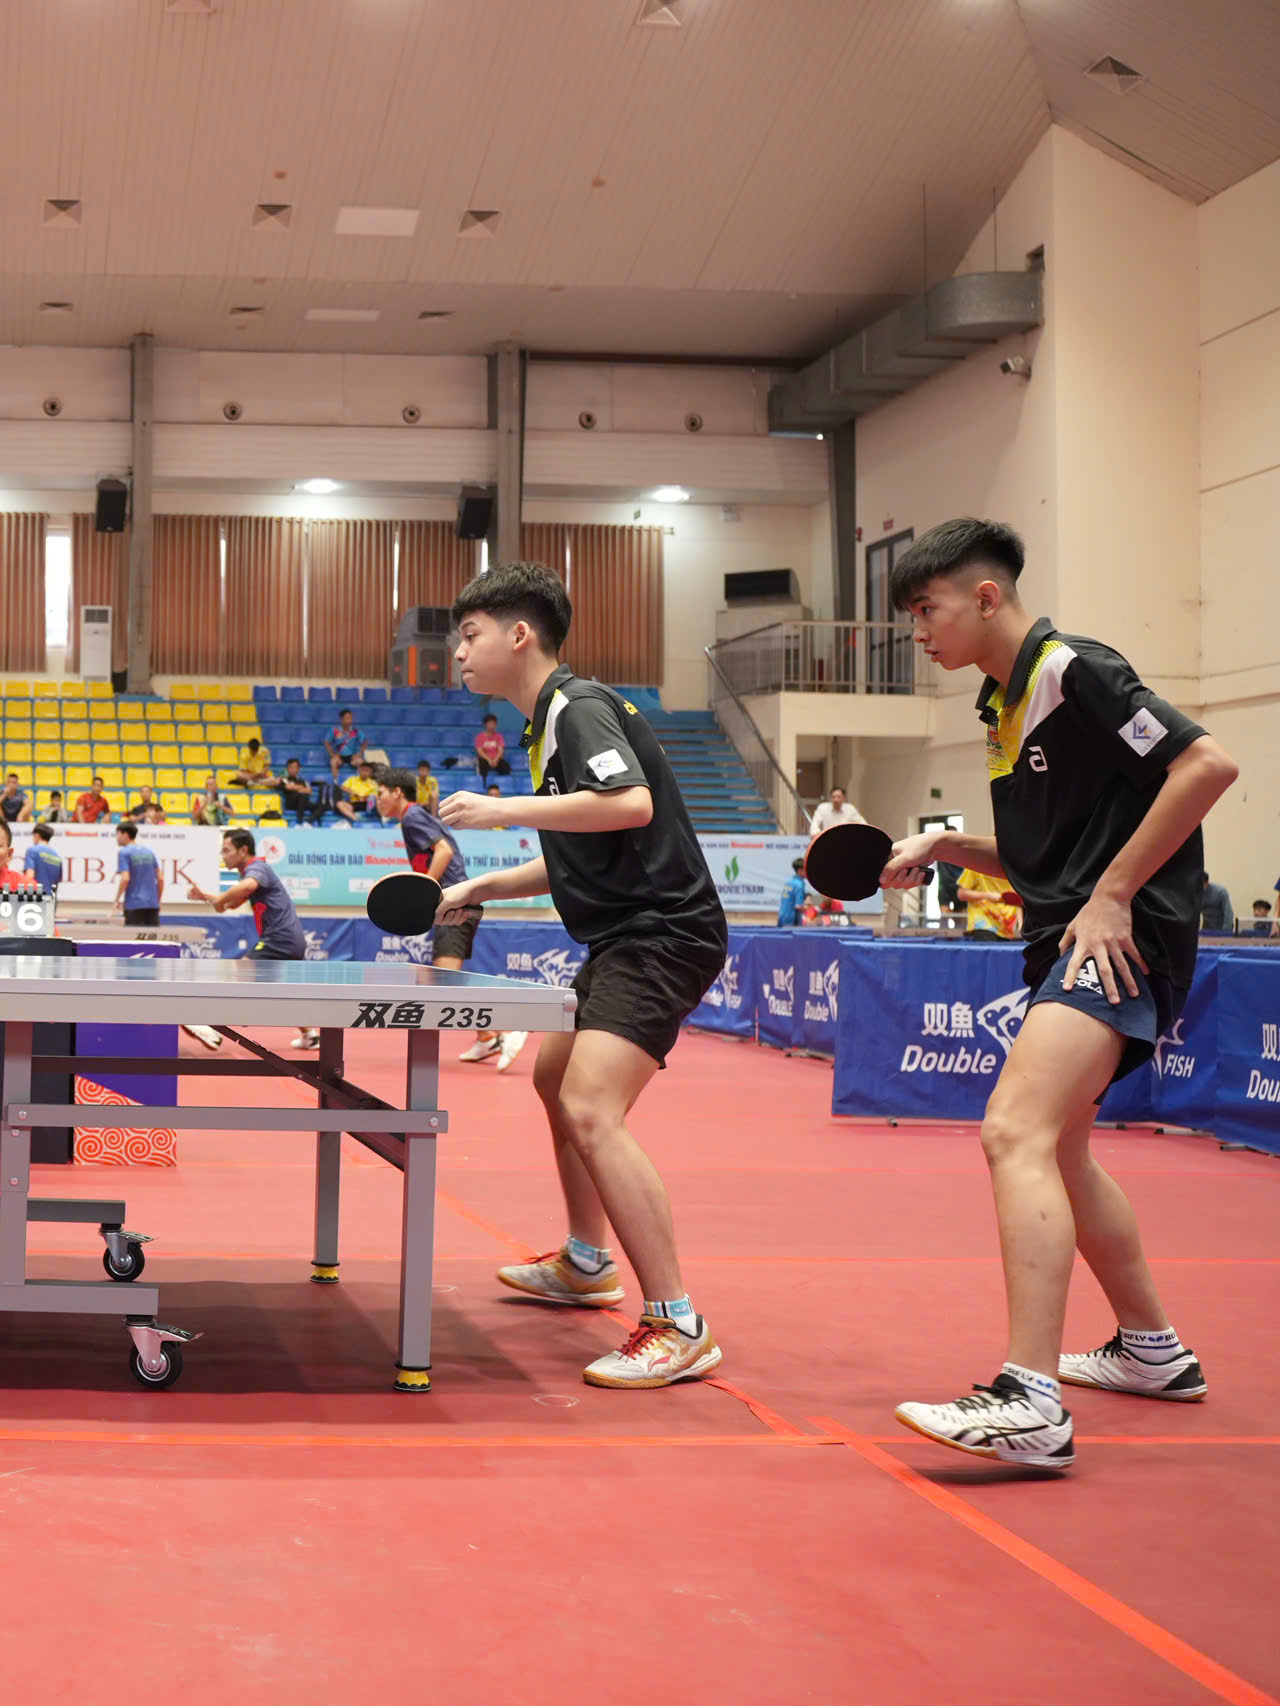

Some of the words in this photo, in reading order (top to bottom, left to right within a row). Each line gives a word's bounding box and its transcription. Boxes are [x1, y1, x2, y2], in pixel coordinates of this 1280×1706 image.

[0, 902, 12, 917] 0
[17, 903, 43, 932] 6
[351, 1001, 426, 1029] 双鱼
[438, 1006, 493, 1029] 235
[921, 1001, 976, 1039] 双魚
[1261, 1023, 1280, 1062] 双
[900, 1044, 997, 1075] Double
[1163, 1054, 1195, 1078] FISH
[1246, 1069, 1280, 1103] Dou
